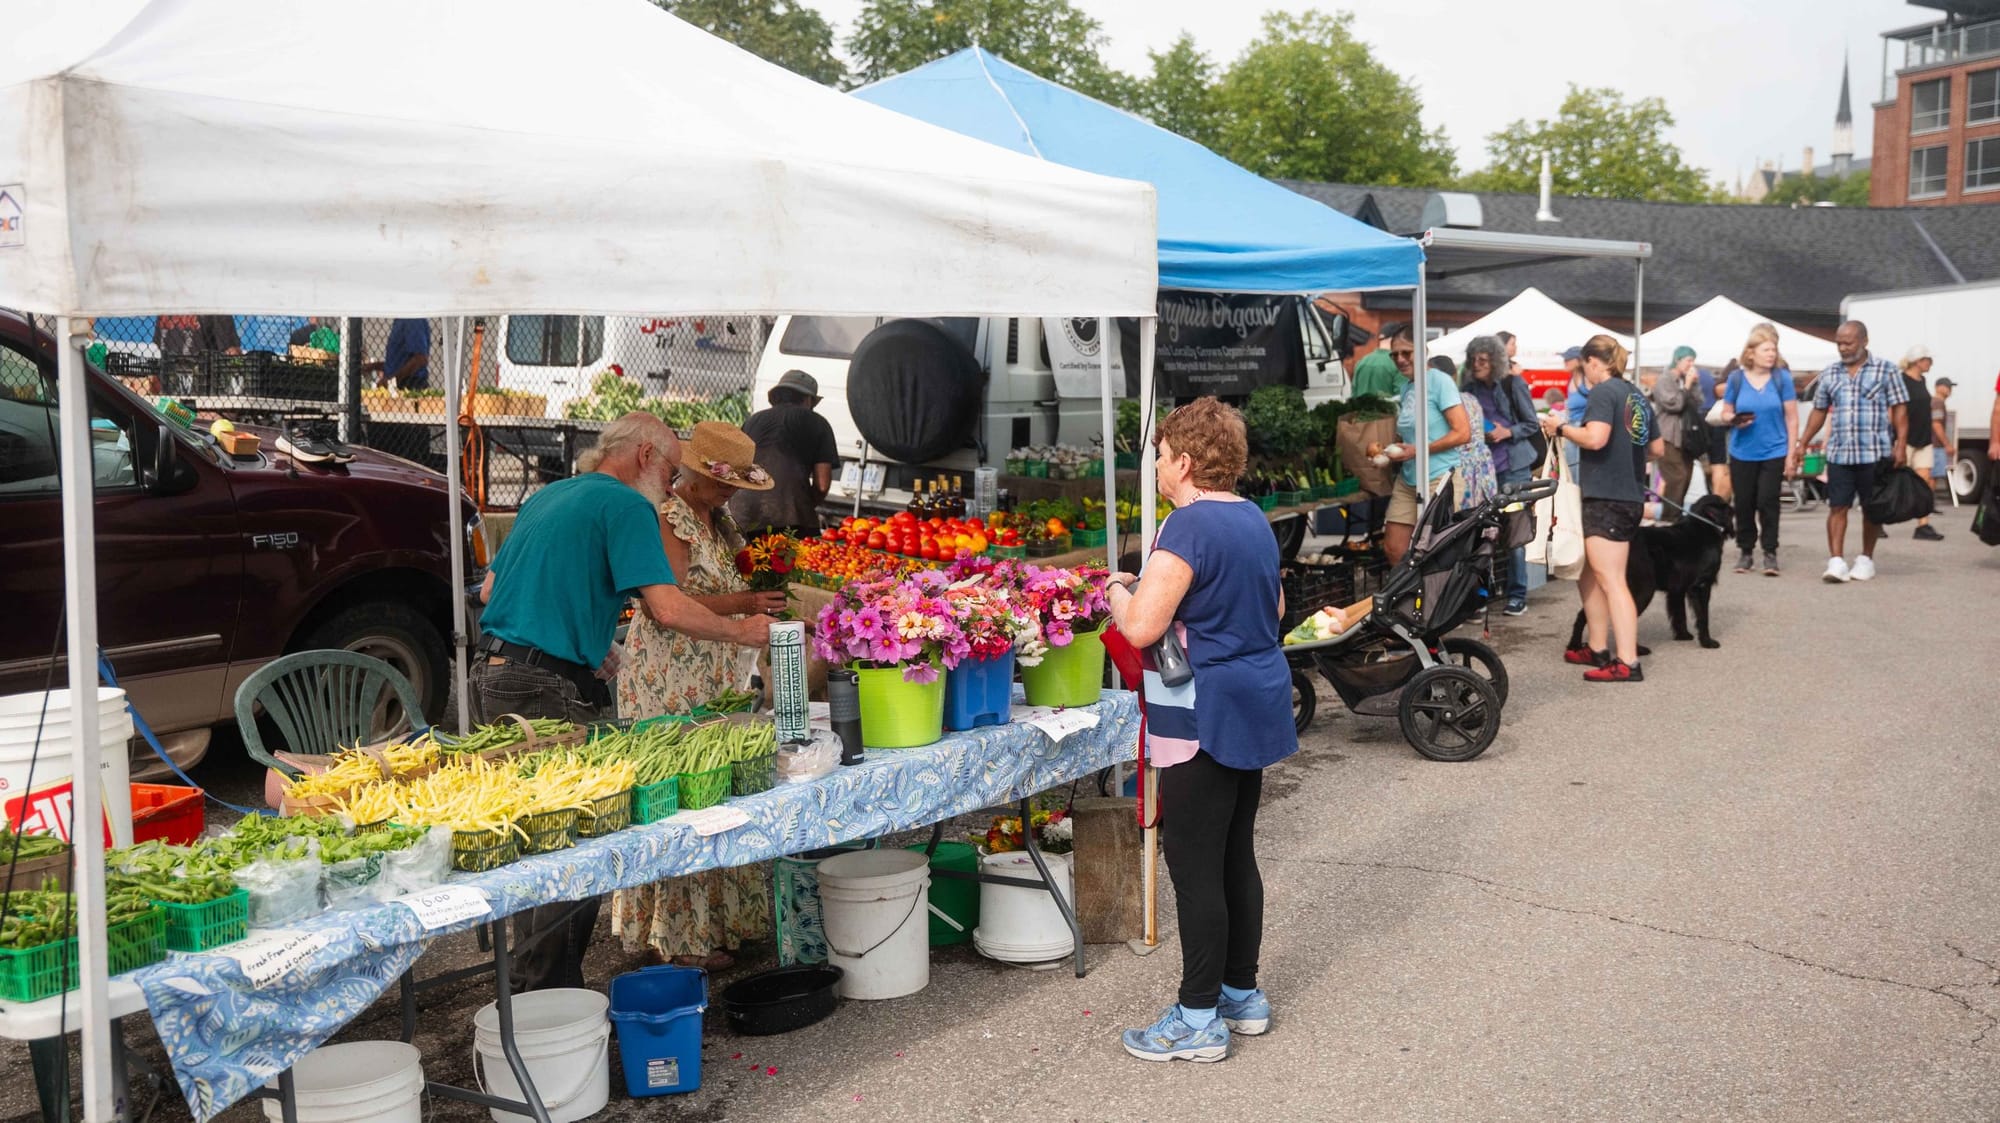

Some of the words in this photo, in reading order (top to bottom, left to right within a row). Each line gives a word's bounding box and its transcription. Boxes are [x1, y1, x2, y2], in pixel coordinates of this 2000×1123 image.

[791, 647, 803, 728] BIODEGRADABLE
[266, 948, 286, 960] From
[255, 967, 282, 988] Product
